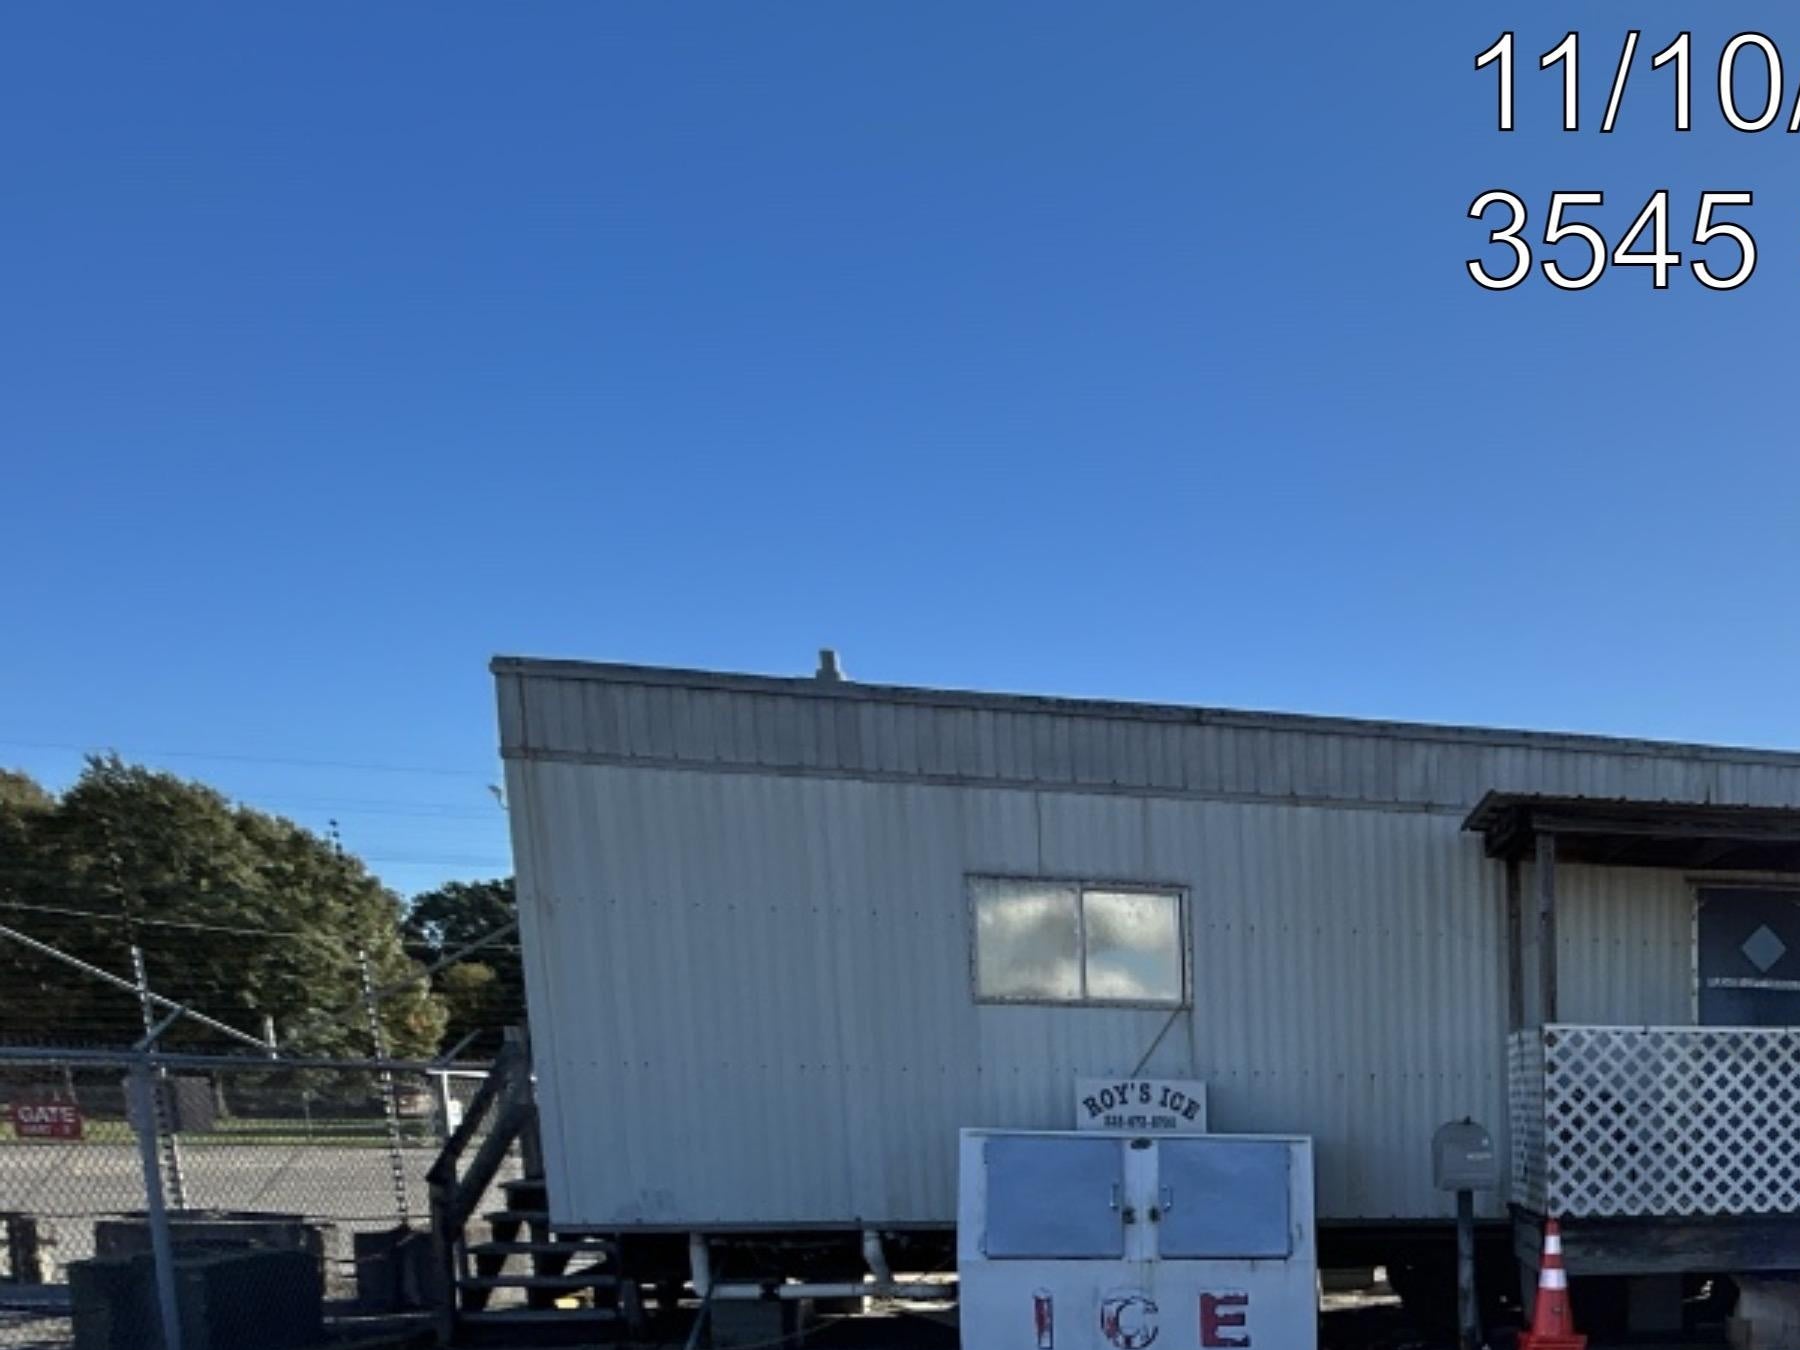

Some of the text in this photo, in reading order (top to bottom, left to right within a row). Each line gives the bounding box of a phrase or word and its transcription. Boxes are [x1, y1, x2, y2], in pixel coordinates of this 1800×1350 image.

[1082, 1082, 1201, 1121] ROY'S ICE
[1033, 1288, 1251, 1350] ICE
